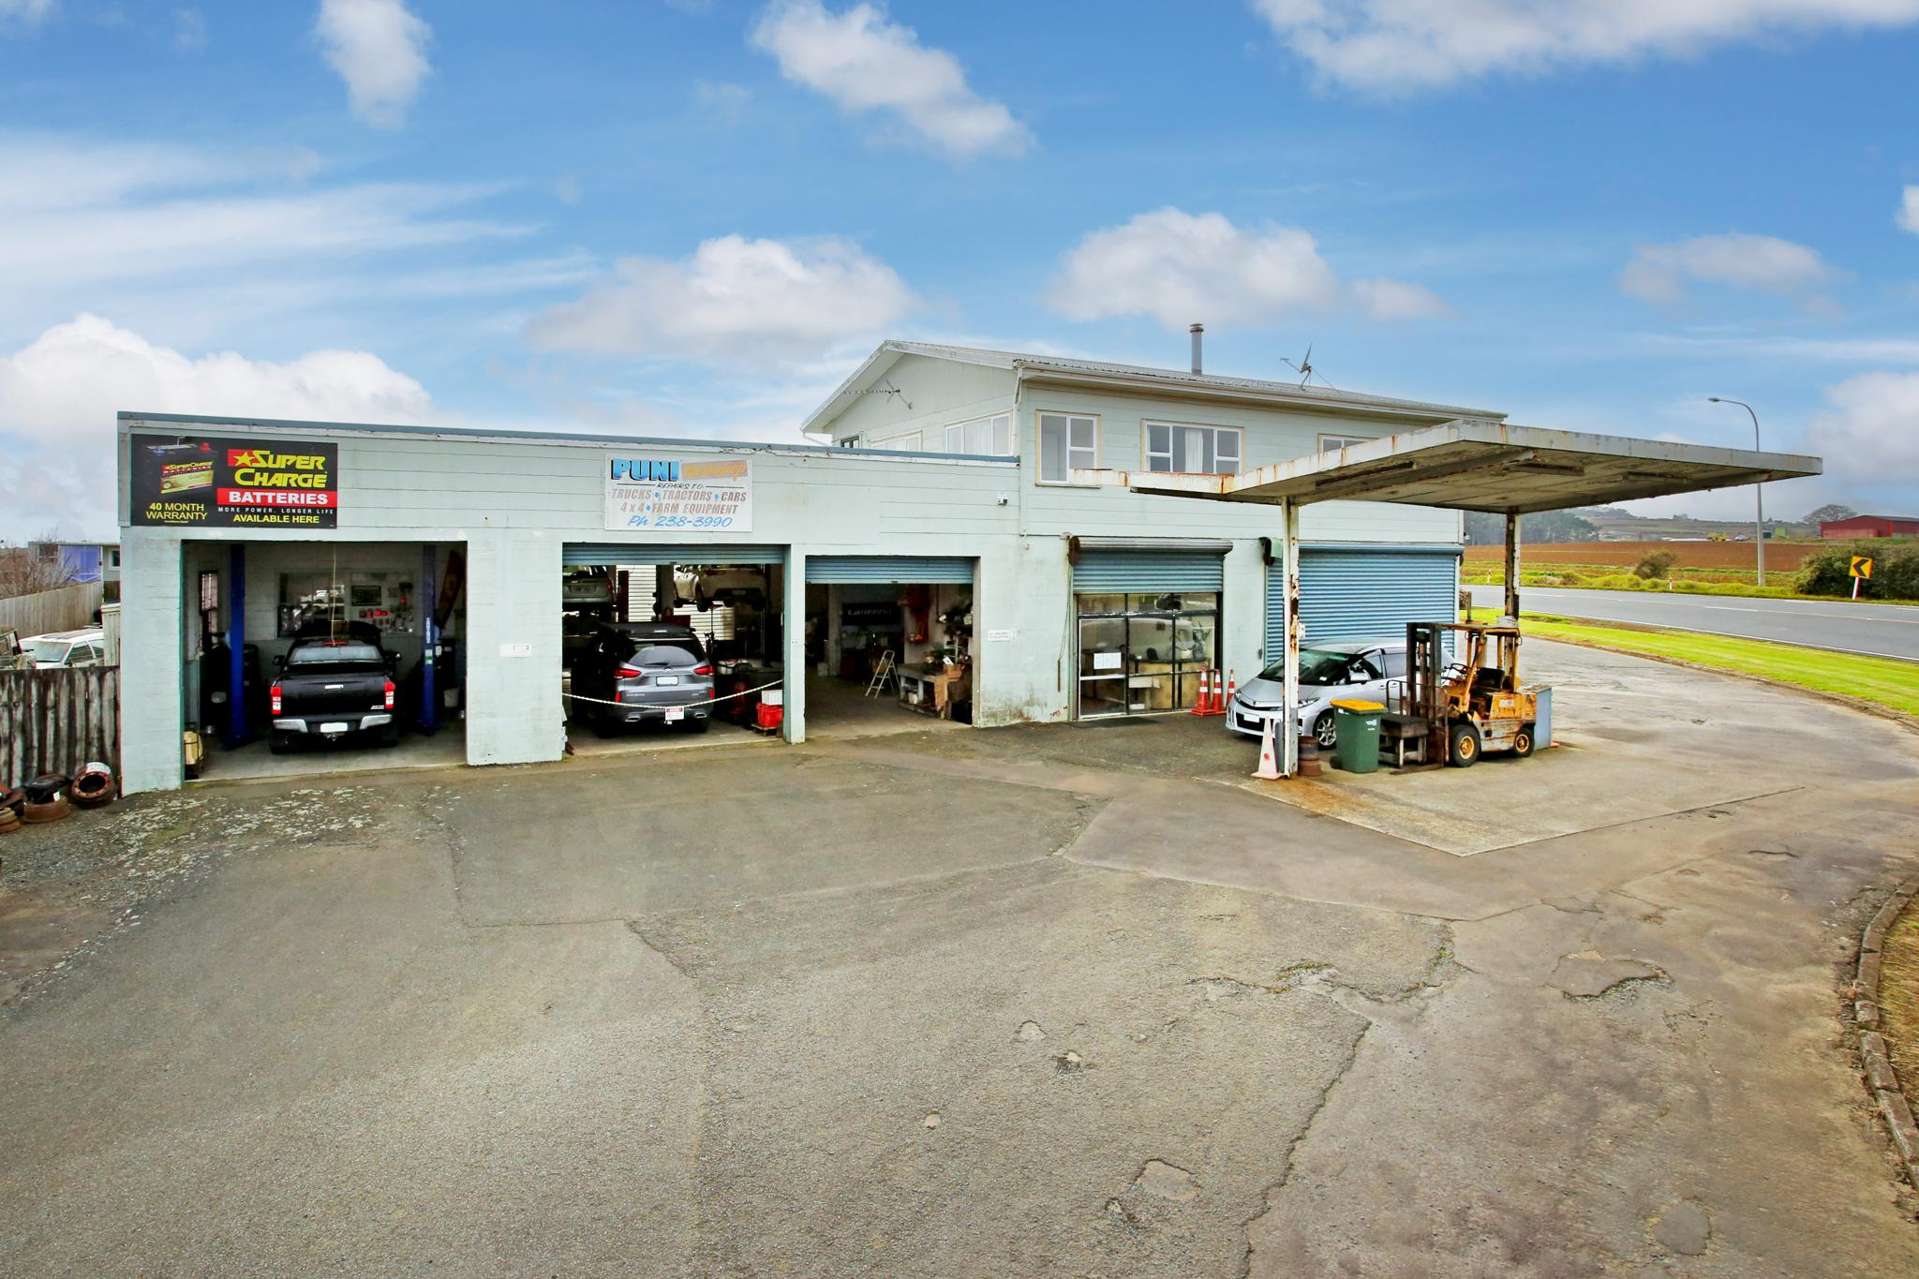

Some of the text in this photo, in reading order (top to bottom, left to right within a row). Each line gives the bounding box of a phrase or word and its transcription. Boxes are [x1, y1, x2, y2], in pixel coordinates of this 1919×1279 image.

[253, 450, 326, 470] SUPER
[611, 459, 680, 481] PUNI
[234, 468, 327, 488] CHARGE
[229, 491, 328, 505] BATTERIES
[612, 489, 747, 501] TRUCKS TRACTORS CARS
[149, 503, 204, 511] 40 MONTH
[652, 503, 680, 514] FARM
[683, 503, 738, 514] EQUIPMENT
[146, 511, 207, 520] WARRANTY
[233, 514, 320, 523] AVAILABLE HERE
[654, 515, 733, 527] 238-3990
